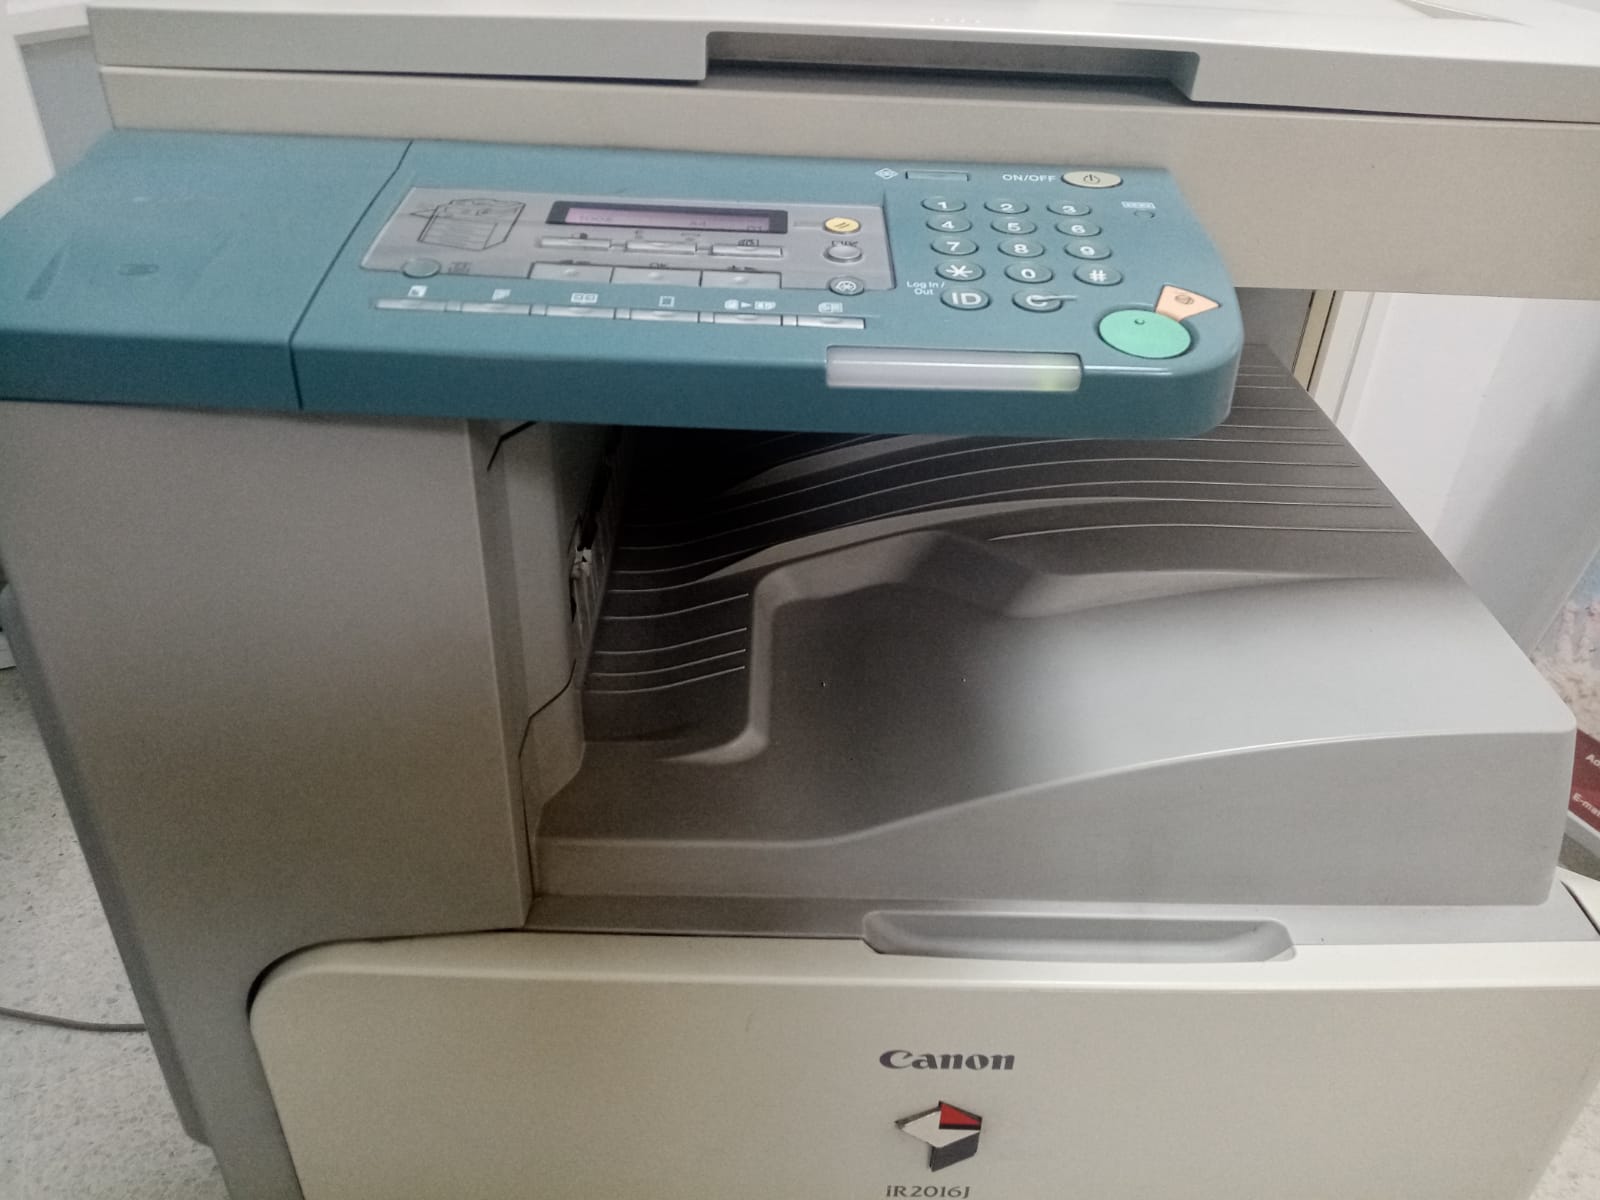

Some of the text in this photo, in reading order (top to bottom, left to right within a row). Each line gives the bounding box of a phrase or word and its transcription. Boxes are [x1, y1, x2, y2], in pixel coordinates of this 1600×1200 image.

[1002, 173, 1056, 183] ON/OFF
[937, 201, 1077, 213] 1 2 3
[941, 220, 1086, 233] 4 5 6
[946, 241, 1095, 256] 7 8 9
[1088, 269, 1107, 282] #
[906, 280, 927, 289] Log
[951, 292, 982, 305] ID
[879, 1049, 1015, 1071] Canon
[886, 1184, 970, 1199] iR2016J
